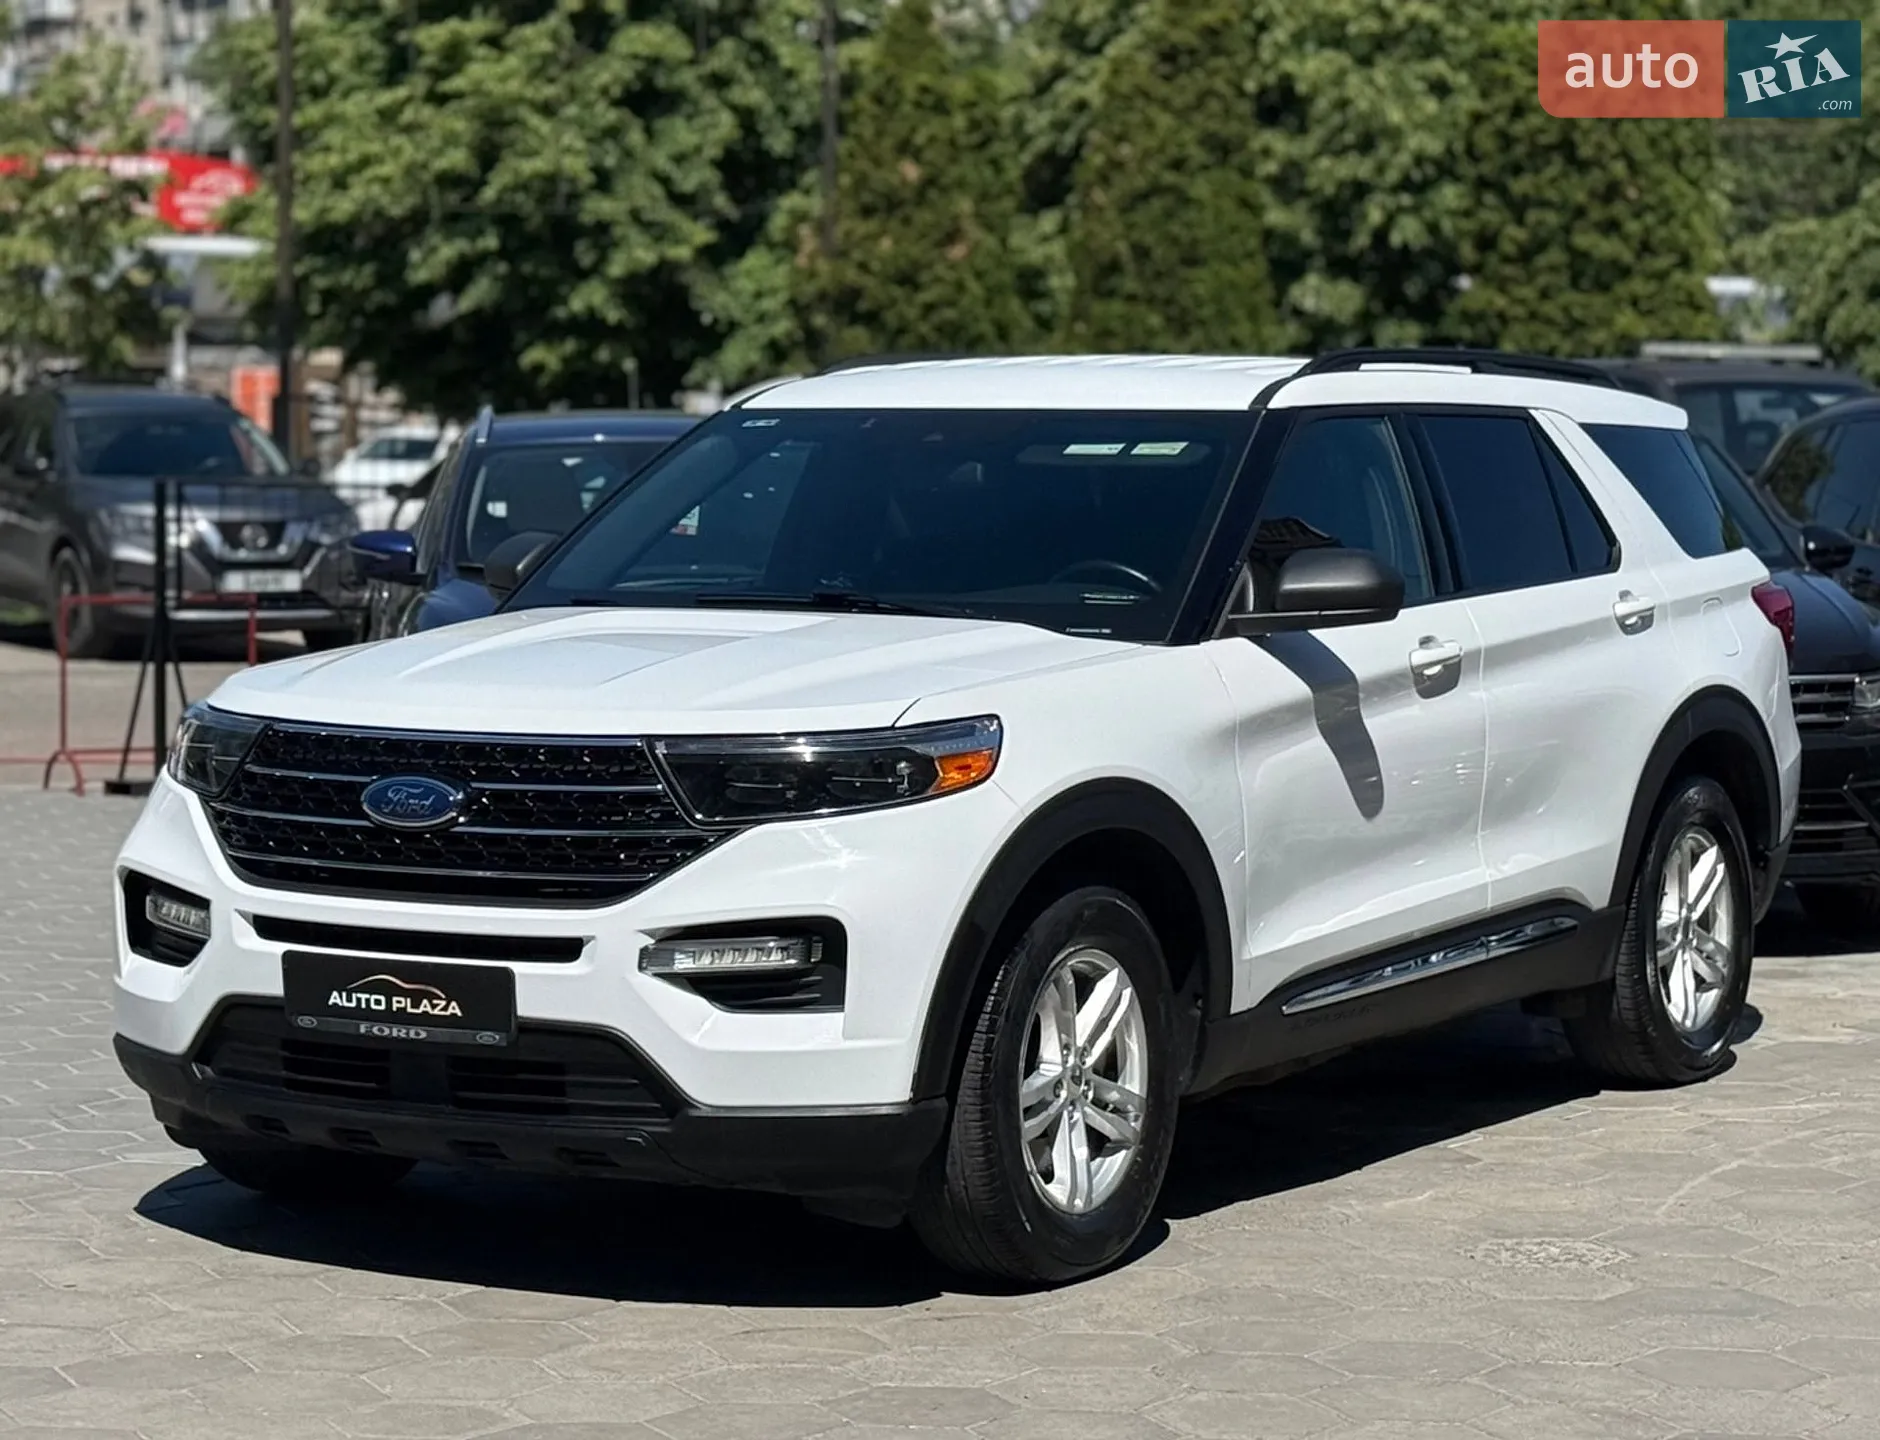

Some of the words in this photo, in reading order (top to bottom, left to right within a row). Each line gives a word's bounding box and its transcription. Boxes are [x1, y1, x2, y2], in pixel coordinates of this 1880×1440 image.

[381, 785, 436, 815] Ford
[328, 990, 386, 1011] AUTO
[392, 996, 462, 1017] PLAZA
[359, 1023, 427, 1041] FORD
